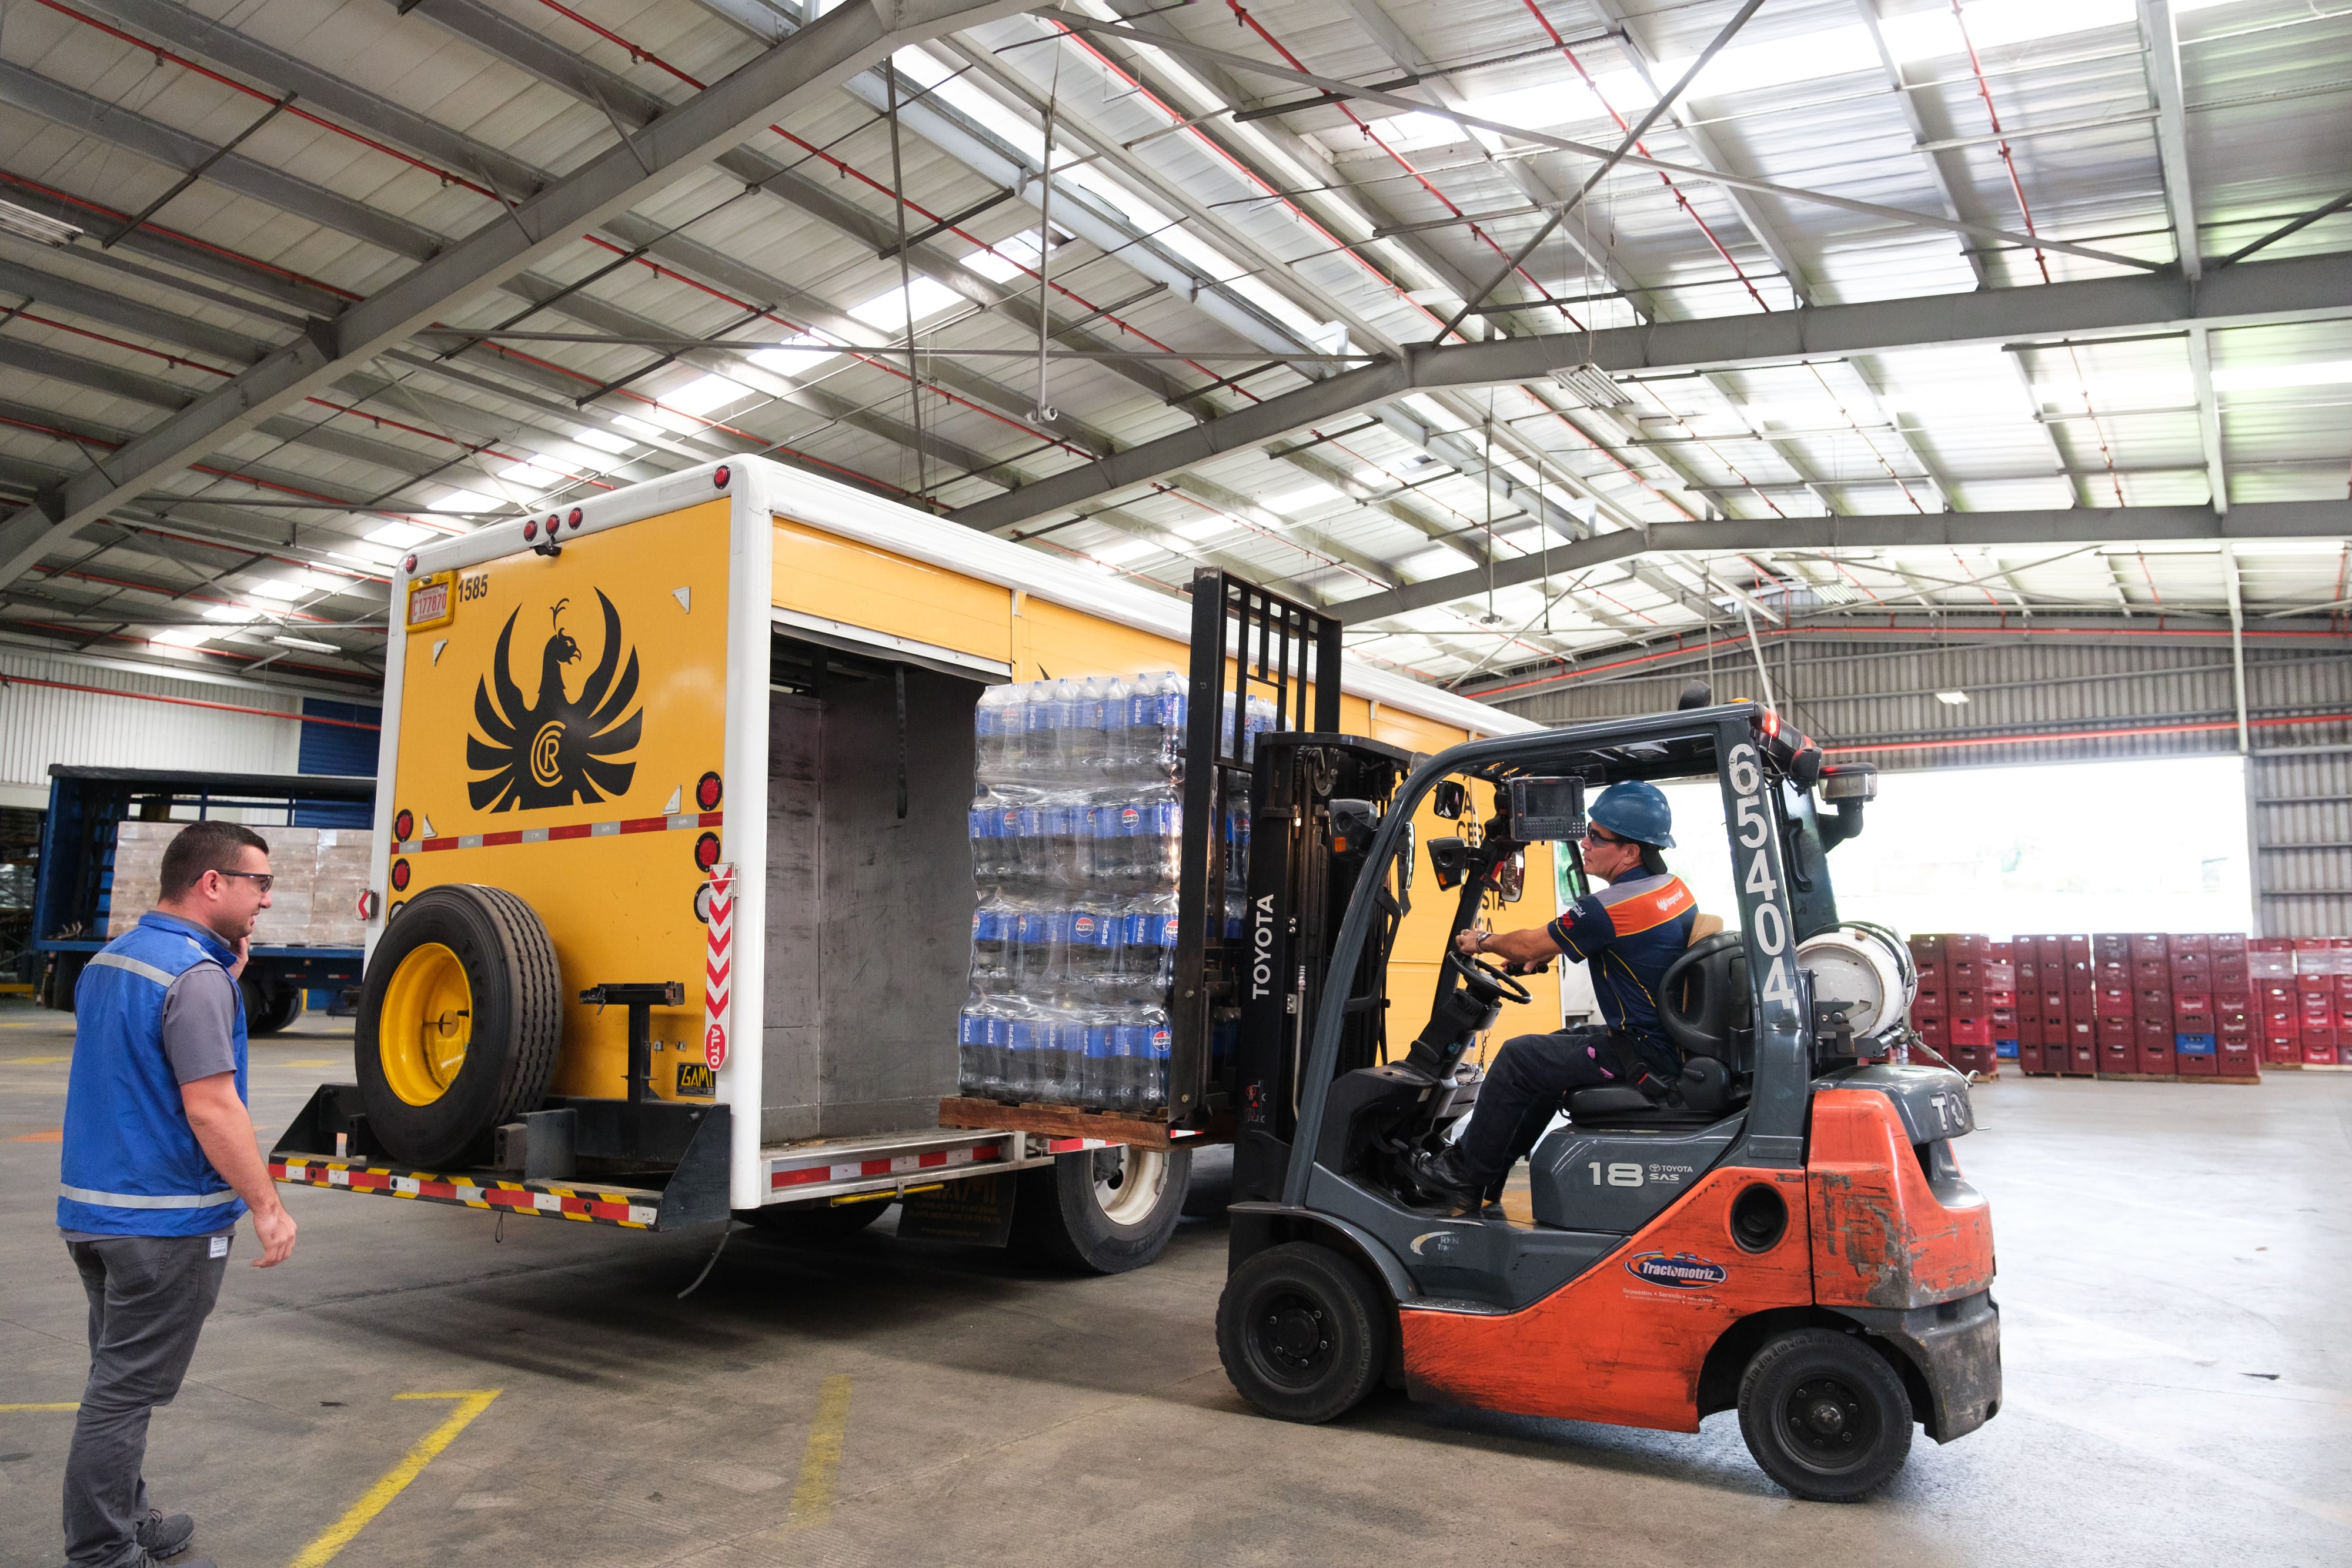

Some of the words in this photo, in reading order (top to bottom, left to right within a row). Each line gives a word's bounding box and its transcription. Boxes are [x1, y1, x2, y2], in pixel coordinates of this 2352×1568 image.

[458, 574, 489, 603] 1585
[412, 592, 447, 617] C177870
[1728, 743, 1794, 1010] 65404
[1666, 888, 1685, 907] Imperial
[1101, 920, 1110, 945] PEPSI
[1137, 918, 1145, 943] PEPSI
[1252, 894, 1274, 1000] TOYOTA
[710, 1028, 721, 1066] ALTO
[1588, 1162, 1644, 1187] 18
[1649, 1173, 1680, 1181] SAS
[1643, 1262, 1715, 1281] Tractomotriz
[1622, 1288, 1652, 1296] Repuestos
